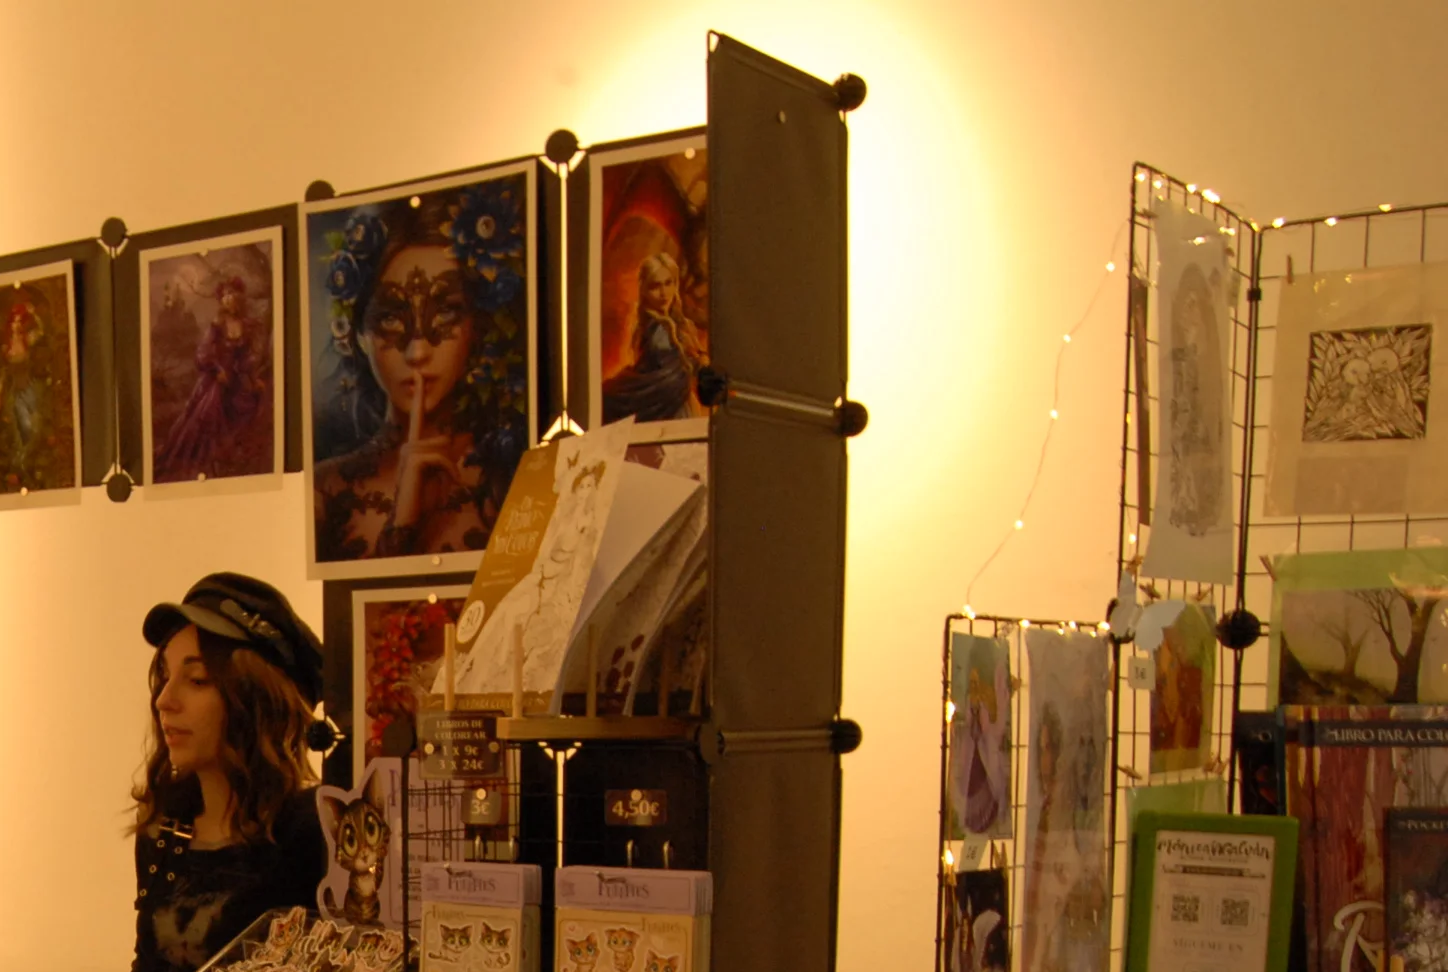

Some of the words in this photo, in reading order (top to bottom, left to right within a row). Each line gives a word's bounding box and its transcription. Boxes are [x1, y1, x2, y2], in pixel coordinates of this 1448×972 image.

[471, 719, 483, 729] DE
[1333, 727, 1374, 742] LIBRO
[1377, 727, 1416, 742] PARA
[1417, 728, 1448, 743] COL
[471, 799, 491, 816] 3€
[612, 800, 660, 820] 4,50€
